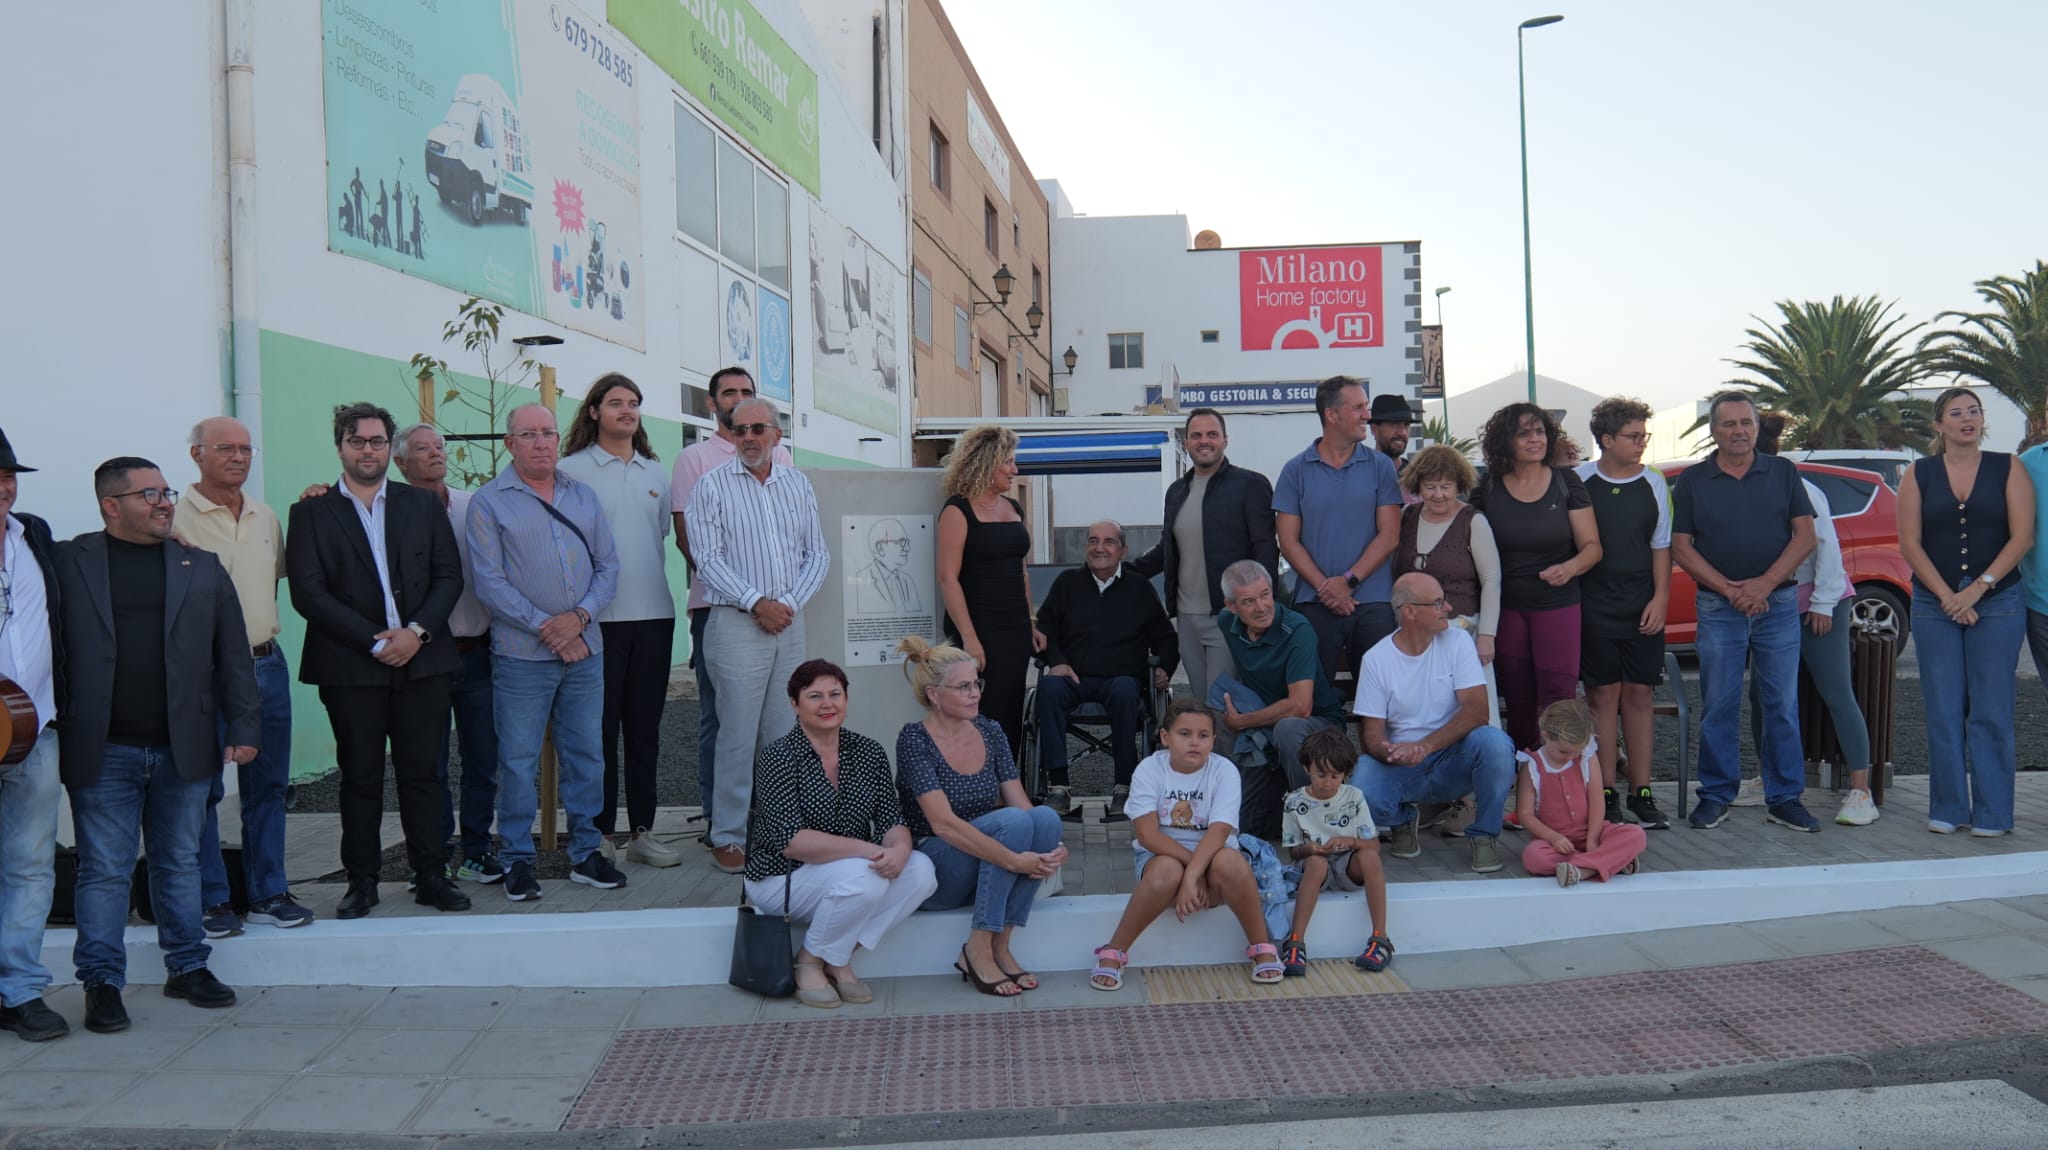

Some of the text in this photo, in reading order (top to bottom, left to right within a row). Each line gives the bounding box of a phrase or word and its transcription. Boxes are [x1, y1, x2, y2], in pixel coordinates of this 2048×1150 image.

[565, 16, 633, 87] 679 728 585
[680, 0, 789, 108] stro Remar
[336, 56, 389, 101] Reformas
[1256, 253, 1367, 285] Milano
[1256, 287, 1367, 307] Home factory
[1344, 318, 1364, 338] H
[1181, 387, 1317, 403] MBO GESTORIA & SEGU
